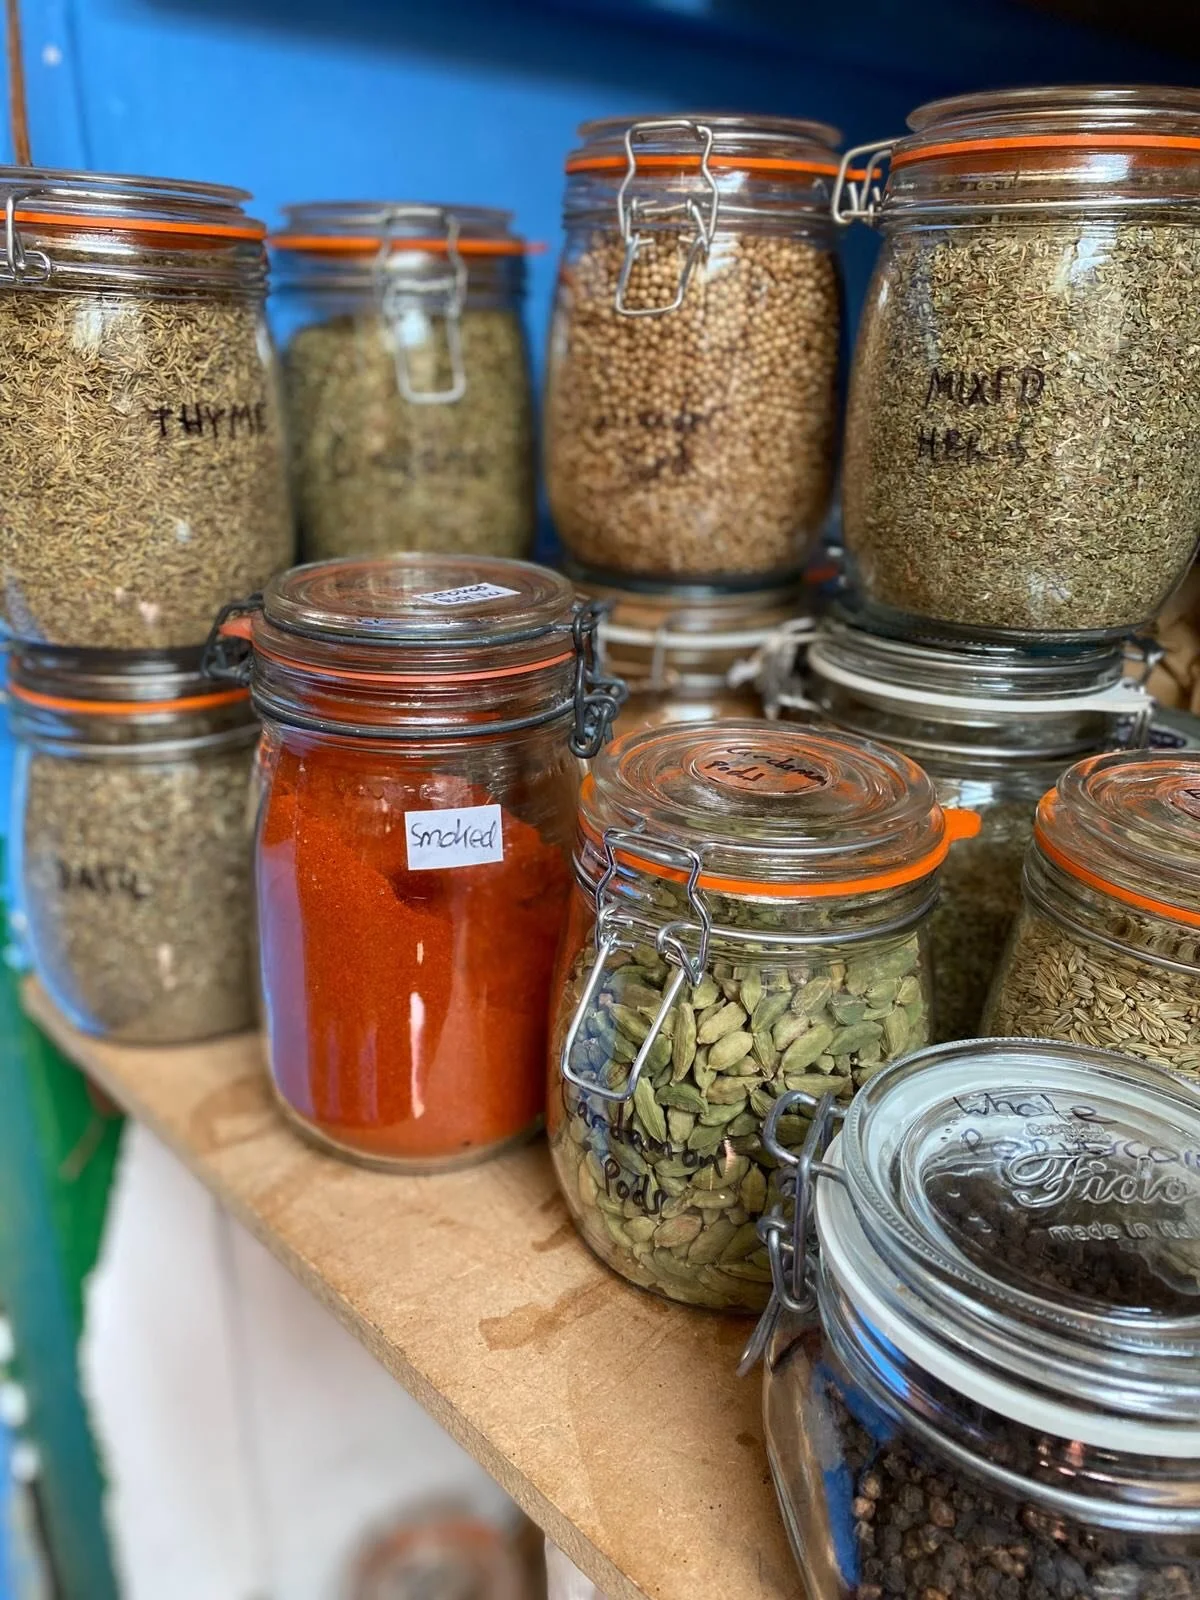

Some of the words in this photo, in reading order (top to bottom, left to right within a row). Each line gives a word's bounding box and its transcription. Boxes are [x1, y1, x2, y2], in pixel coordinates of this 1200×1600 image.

[151, 401, 268, 440] THYME
[411, 818, 497, 848] Smoked
[1007, 1153, 1196, 1208] Fido
[1047, 1220, 1120, 1241] made
[1125, 1221, 1153, 1239] in
